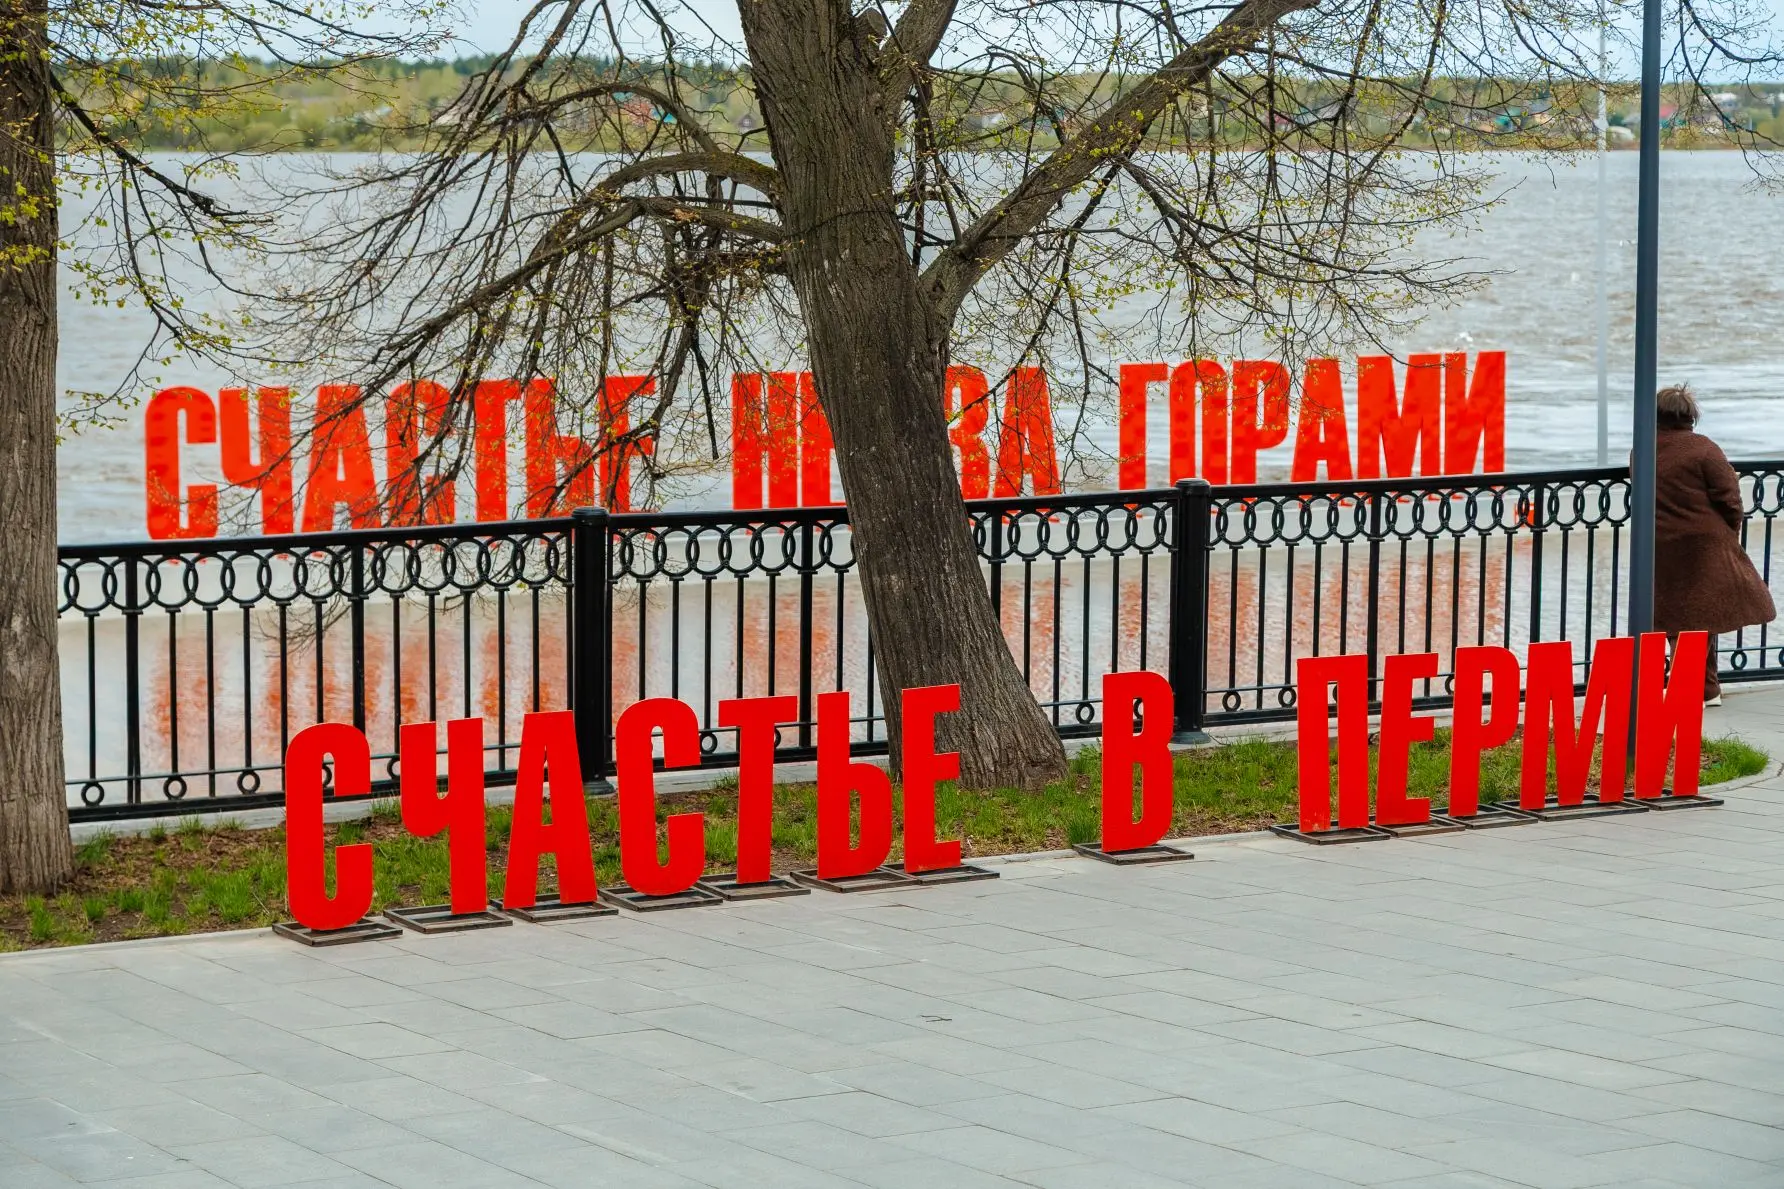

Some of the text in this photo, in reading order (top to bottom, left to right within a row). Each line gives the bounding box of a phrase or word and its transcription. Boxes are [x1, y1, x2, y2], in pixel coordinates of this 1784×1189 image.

[145, 374, 656, 541] СЧАСТЬЕ
[1119, 351, 1506, 502] ГОРАМИ
[285, 631, 1709, 931] СЧАСТЬЕ В ПЕРМИ
